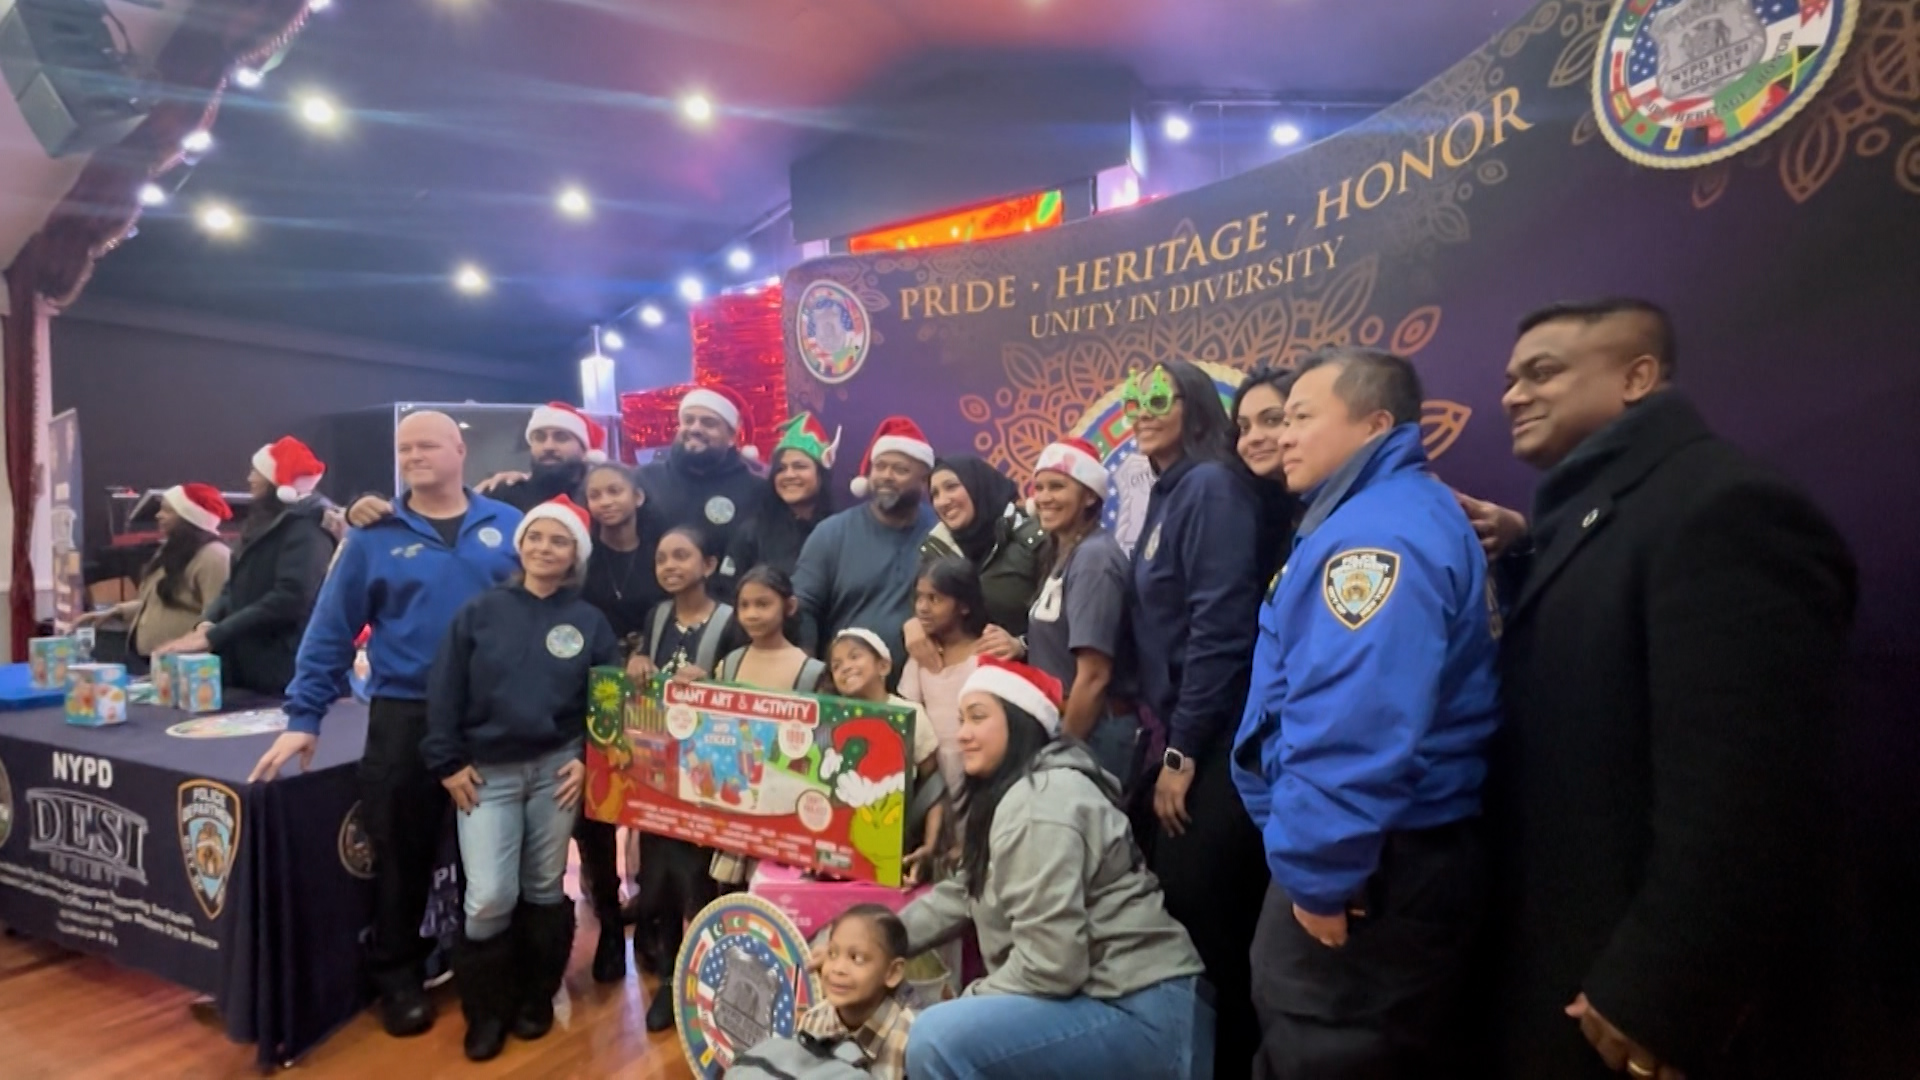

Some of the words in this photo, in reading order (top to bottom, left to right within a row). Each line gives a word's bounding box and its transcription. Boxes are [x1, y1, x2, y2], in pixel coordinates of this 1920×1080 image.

[1671, 59, 1709, 82] NYPD
[1713, 43, 1749, 65] DESI
[1680, 57, 1742, 90] SOCIETY
[900, 274, 1016, 321] PRIDE
[1056, 211, 1269, 299] HERITAGE
[1313, 86, 1534, 230] HONOR
[1030, 301, 1123, 339] UNITY
[1128, 293, 1161, 321] IN
[1168, 236, 1344, 314] DIVERSITY
[710, 691, 735, 709] ART
[752, 699, 812, 720] ACTIVITY
[52, 751, 113, 789] NYPD
[26, 788, 149, 886] DESI
